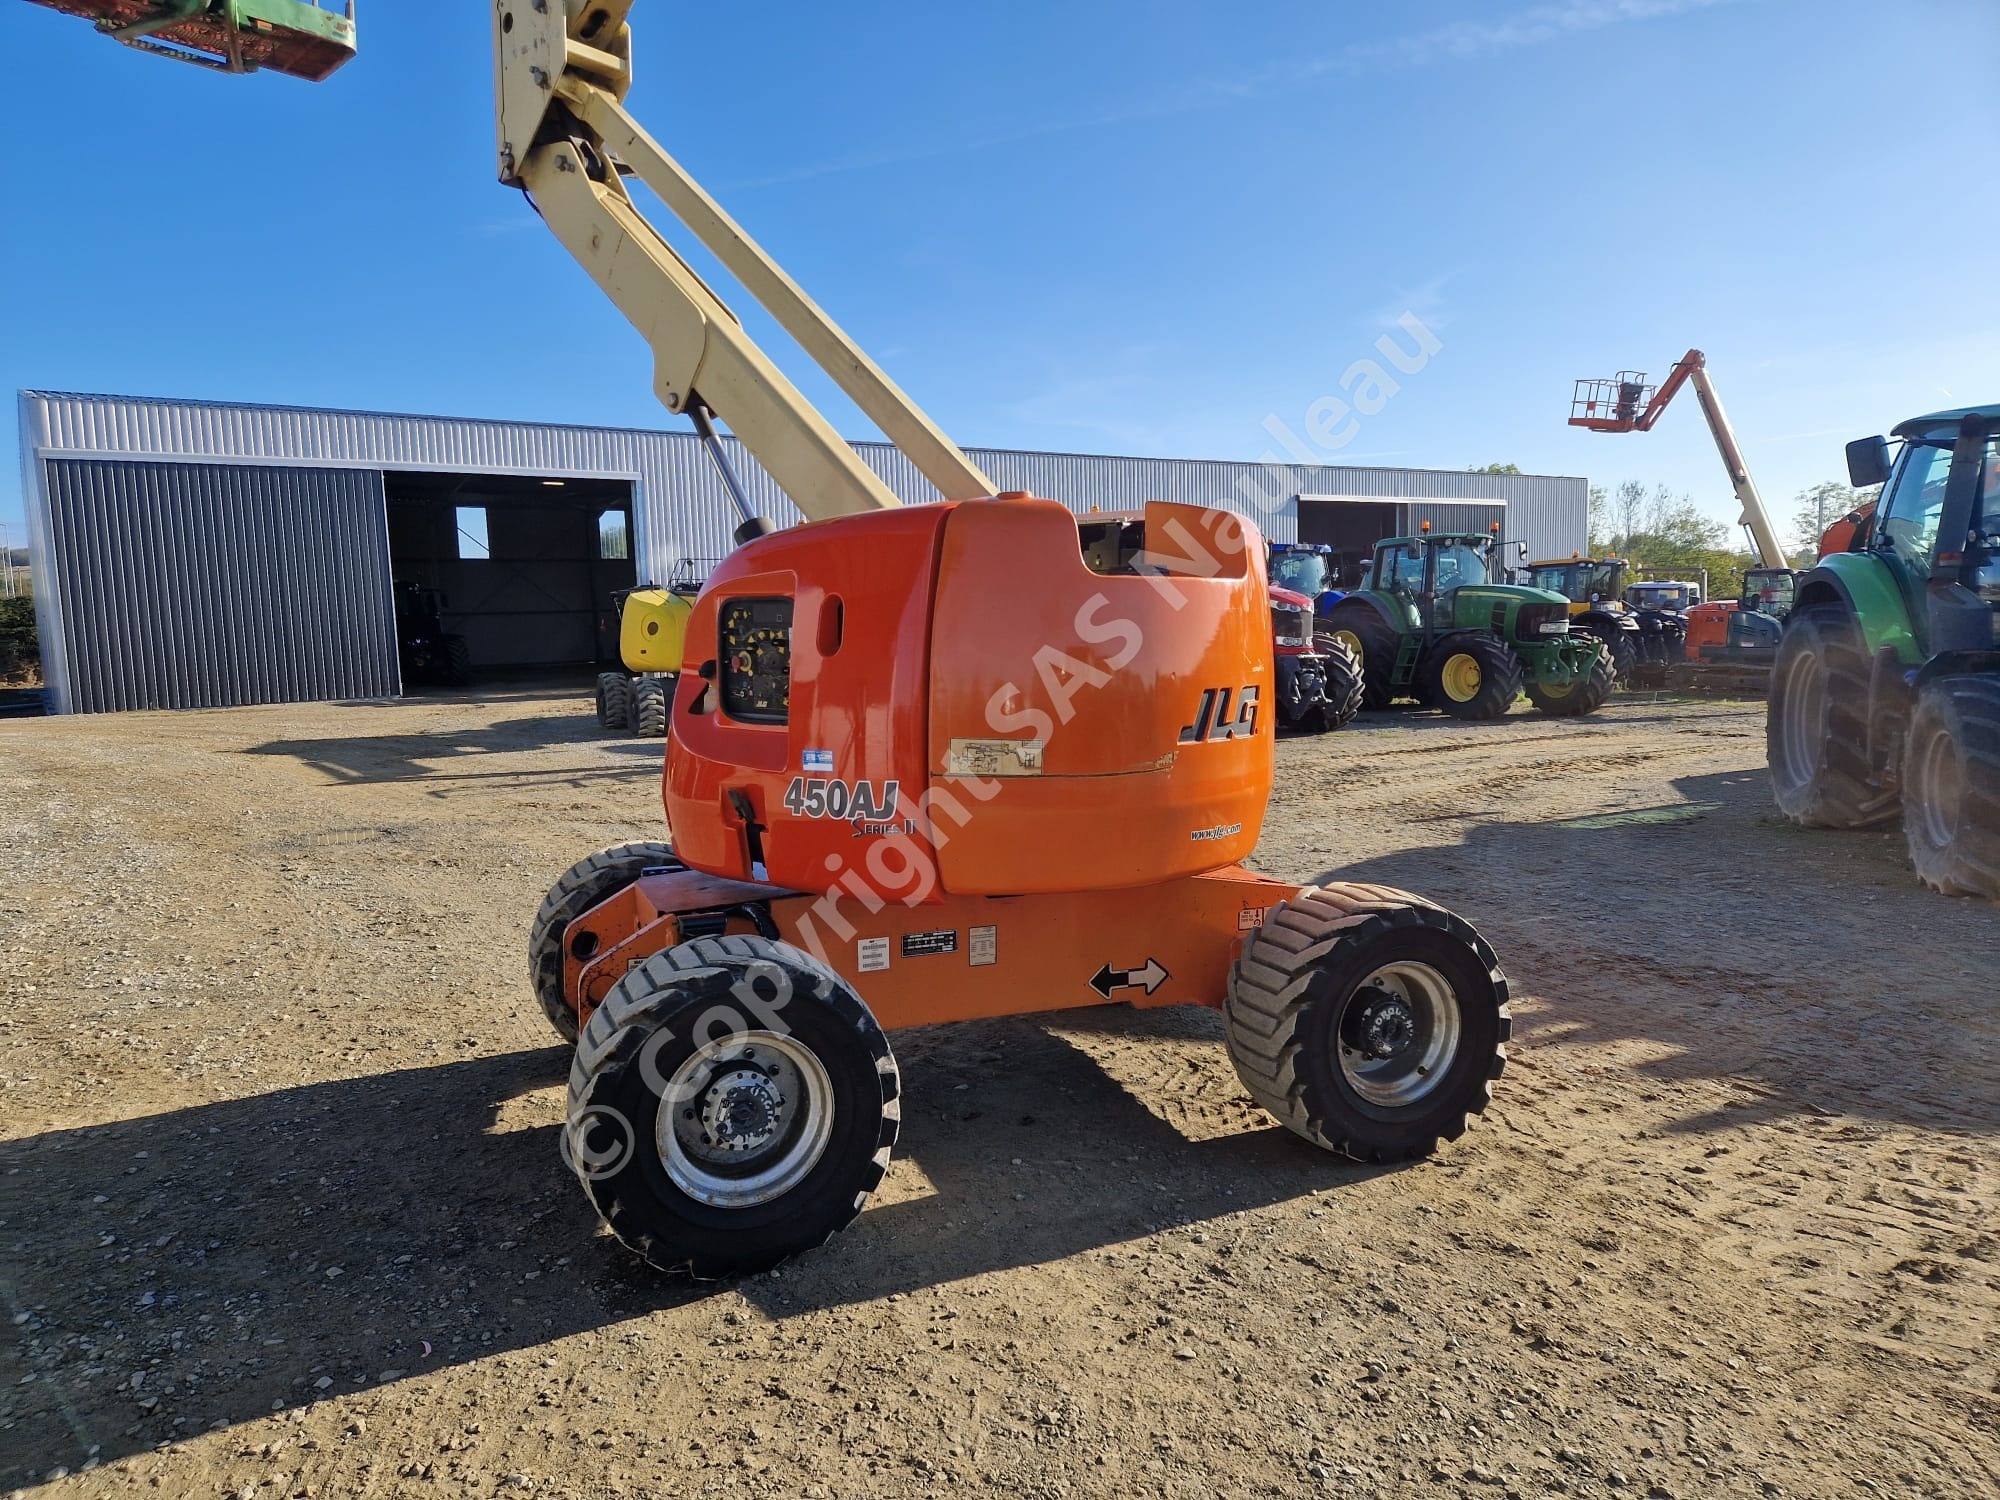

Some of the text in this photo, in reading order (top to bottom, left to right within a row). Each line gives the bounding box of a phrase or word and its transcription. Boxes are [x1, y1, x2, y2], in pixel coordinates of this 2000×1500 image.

[1177, 684, 1260, 745] JLG
[783, 777, 899, 821] 450AJ
[1191, 823, 1241, 840] www.jlg.com
